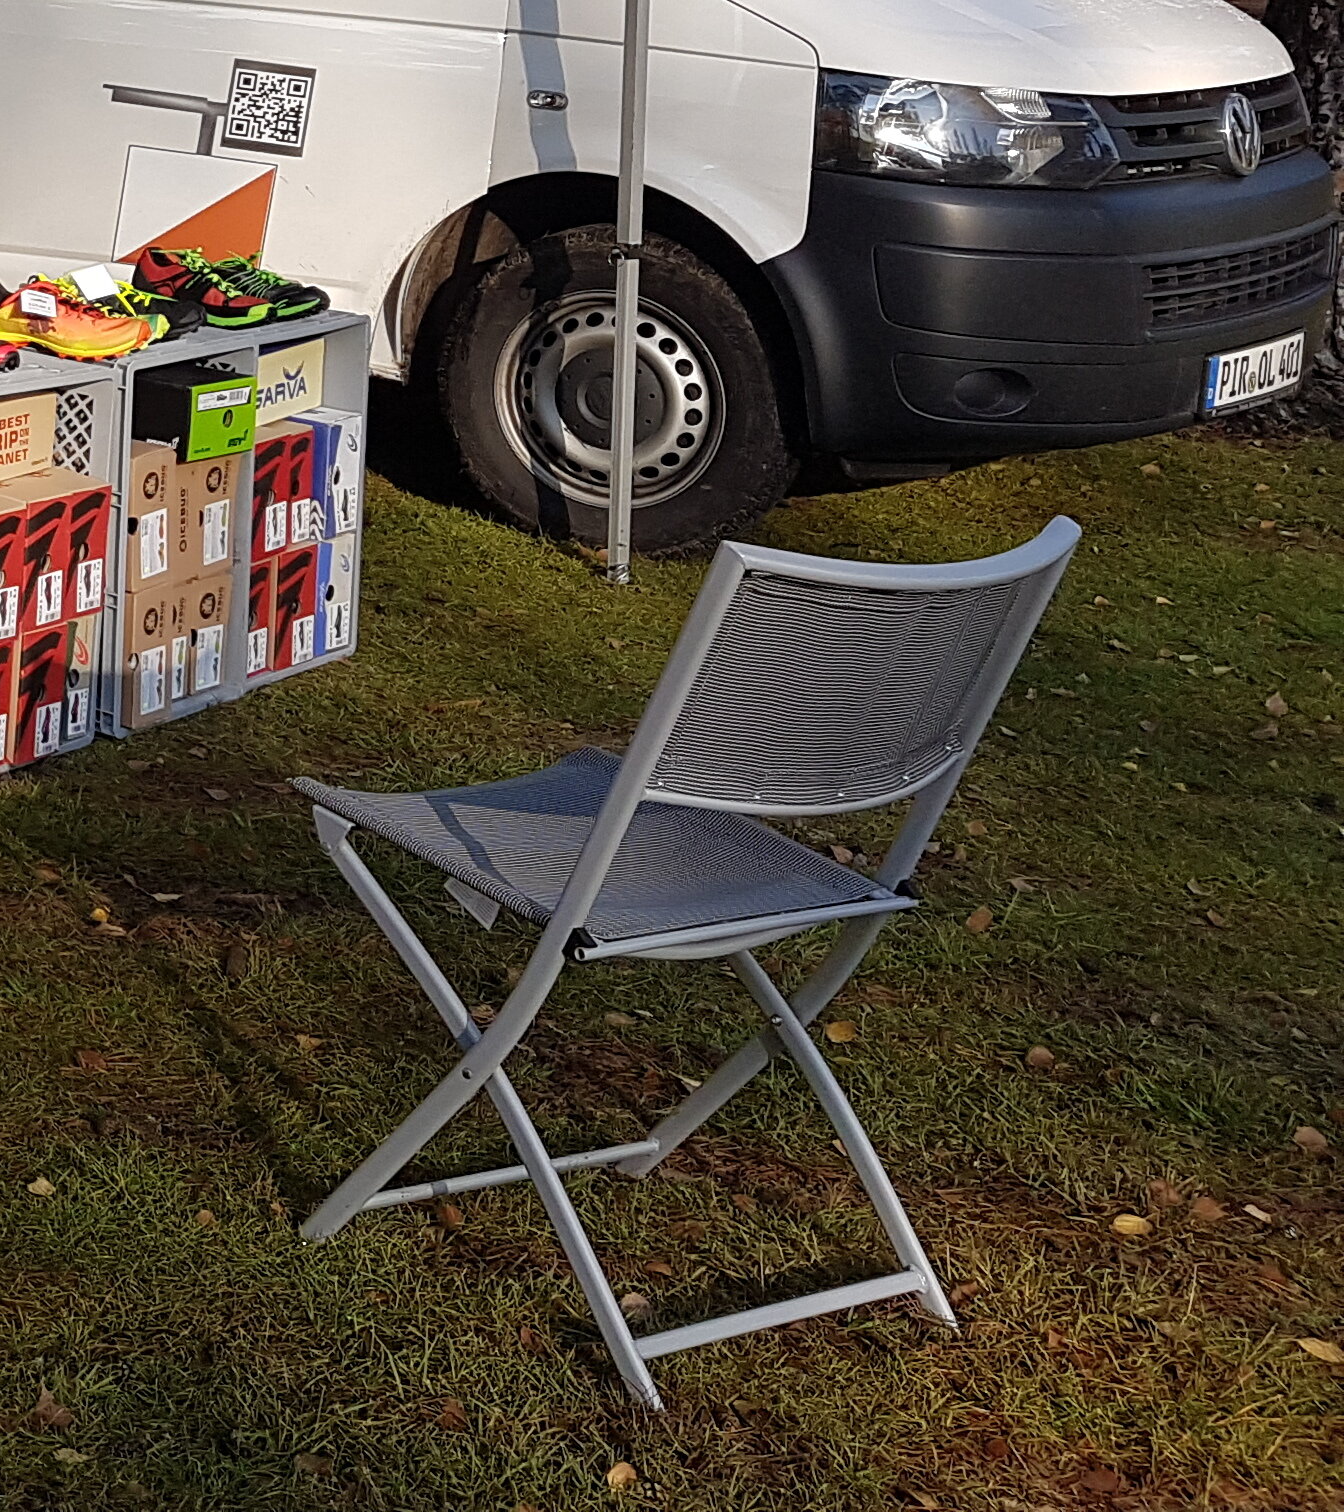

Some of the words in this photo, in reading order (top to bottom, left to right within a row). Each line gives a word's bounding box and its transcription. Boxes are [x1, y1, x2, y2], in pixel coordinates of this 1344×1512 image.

[1218, 355, 1250, 401] PIR
[1257, 349, 1276, 390] OL
[0, 414, 31, 431] BEST
[19, 427, 30, 438] ON
